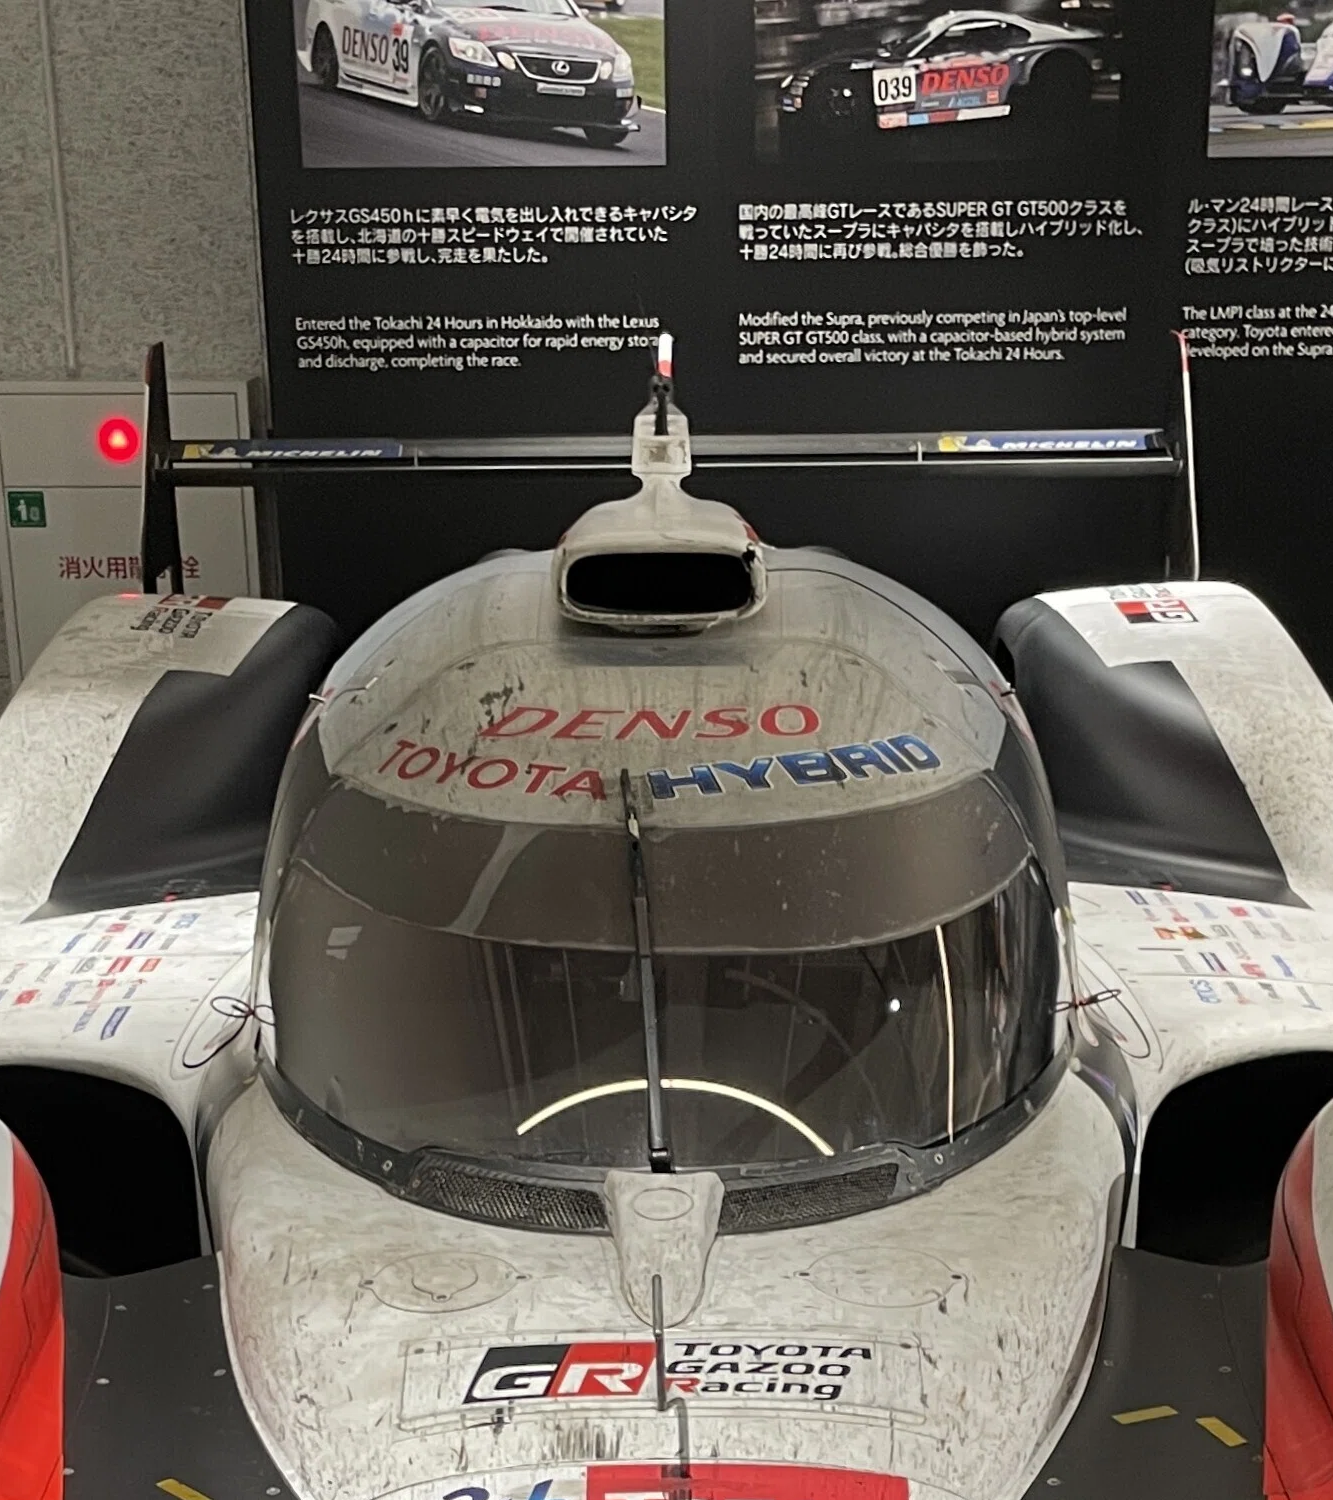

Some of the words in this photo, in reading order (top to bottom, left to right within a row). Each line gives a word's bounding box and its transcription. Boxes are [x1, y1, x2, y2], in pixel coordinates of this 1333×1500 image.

[342, 26, 389, 66] DENSO
[391, 37, 410, 73] 39
[878, 75, 912, 101] 039
[921, 64, 1010, 96] DENSO
[295, 316, 346, 331] Entered
[348, 316, 371, 331] the
[373, 315, 423, 331] Tokachi
[426, 315, 441, 330] 24
[444, 316, 484, 330] Hours
[486, 316, 499, 329] in
[500, 314, 563, 330] Hokkaido
[565, 313, 595, 329] with
[597, 313, 621, 329] the
[622, 314, 660, 329] Lexus
[738, 310, 799, 327] Modified
[801, 311, 824, 326] the
[867, 309, 934, 329] previously
[935, 311, 1006, 328] competing
[1008, 310, 1021, 323] in
[1021, 308, 1066, 327] Japan's
[1069, 307, 1127, 326] top-level
[1182, 305, 1208, 321] The
[1210, 305, 1243, 320] LMP1
[1245, 304, 1276, 320] class
[1278, 306, 1292, 319] at
[1295, 303, 1318, 319] the
[352, 334, 414, 353] equipped
[417, 334, 446, 349] with
[449, 337, 457, 349] a
[459, 335, 520, 352] capacitor
[522, 333, 543, 348] for
[545, 332, 578, 351] rapid
[580, 336, 625, 352] energy
[739, 330, 781, 346] SUPER
[782, 330, 804, 345] GT
[805, 330, 850, 345] GT500
[887, 329, 917, 343] with
[919, 332, 928, 343] a
[929, 327, 1033, 347] capacitor-based
[1035, 327, 1078, 345] hybrid
[1080, 328, 1126, 345] system
[1243, 323, 1288, 342] Toyota
[738, 348, 764, 364] and
[765, 348, 817, 364] secured
[818, 347, 862, 364] overall
[864, 350, 910, 366] victory
[912, 349, 926, 362] at
[928, 346, 951, 362] the
[953, 346, 1003, 362] Tokachi
[1005, 346, 1021, 361] 24
[1251, 345, 1270, 357] on
[1272, 341, 1295, 357] the
[1297, 341, 1333, 360] Supra
[298, 353, 322, 368] and
[390, 353, 464, 372] completing
[466, 353, 489, 368] the
[479, 704, 820, 740] DENSO
[377, 738, 607, 802] TOYOTA
[648, 733, 942, 800] HYBRID
[673, 1342, 873, 1360] TOYOTA
[464, 1348, 648, 1404] GR
[665, 1360, 852, 1377] GAZOO
[666, 1376, 844, 1400] Racing
